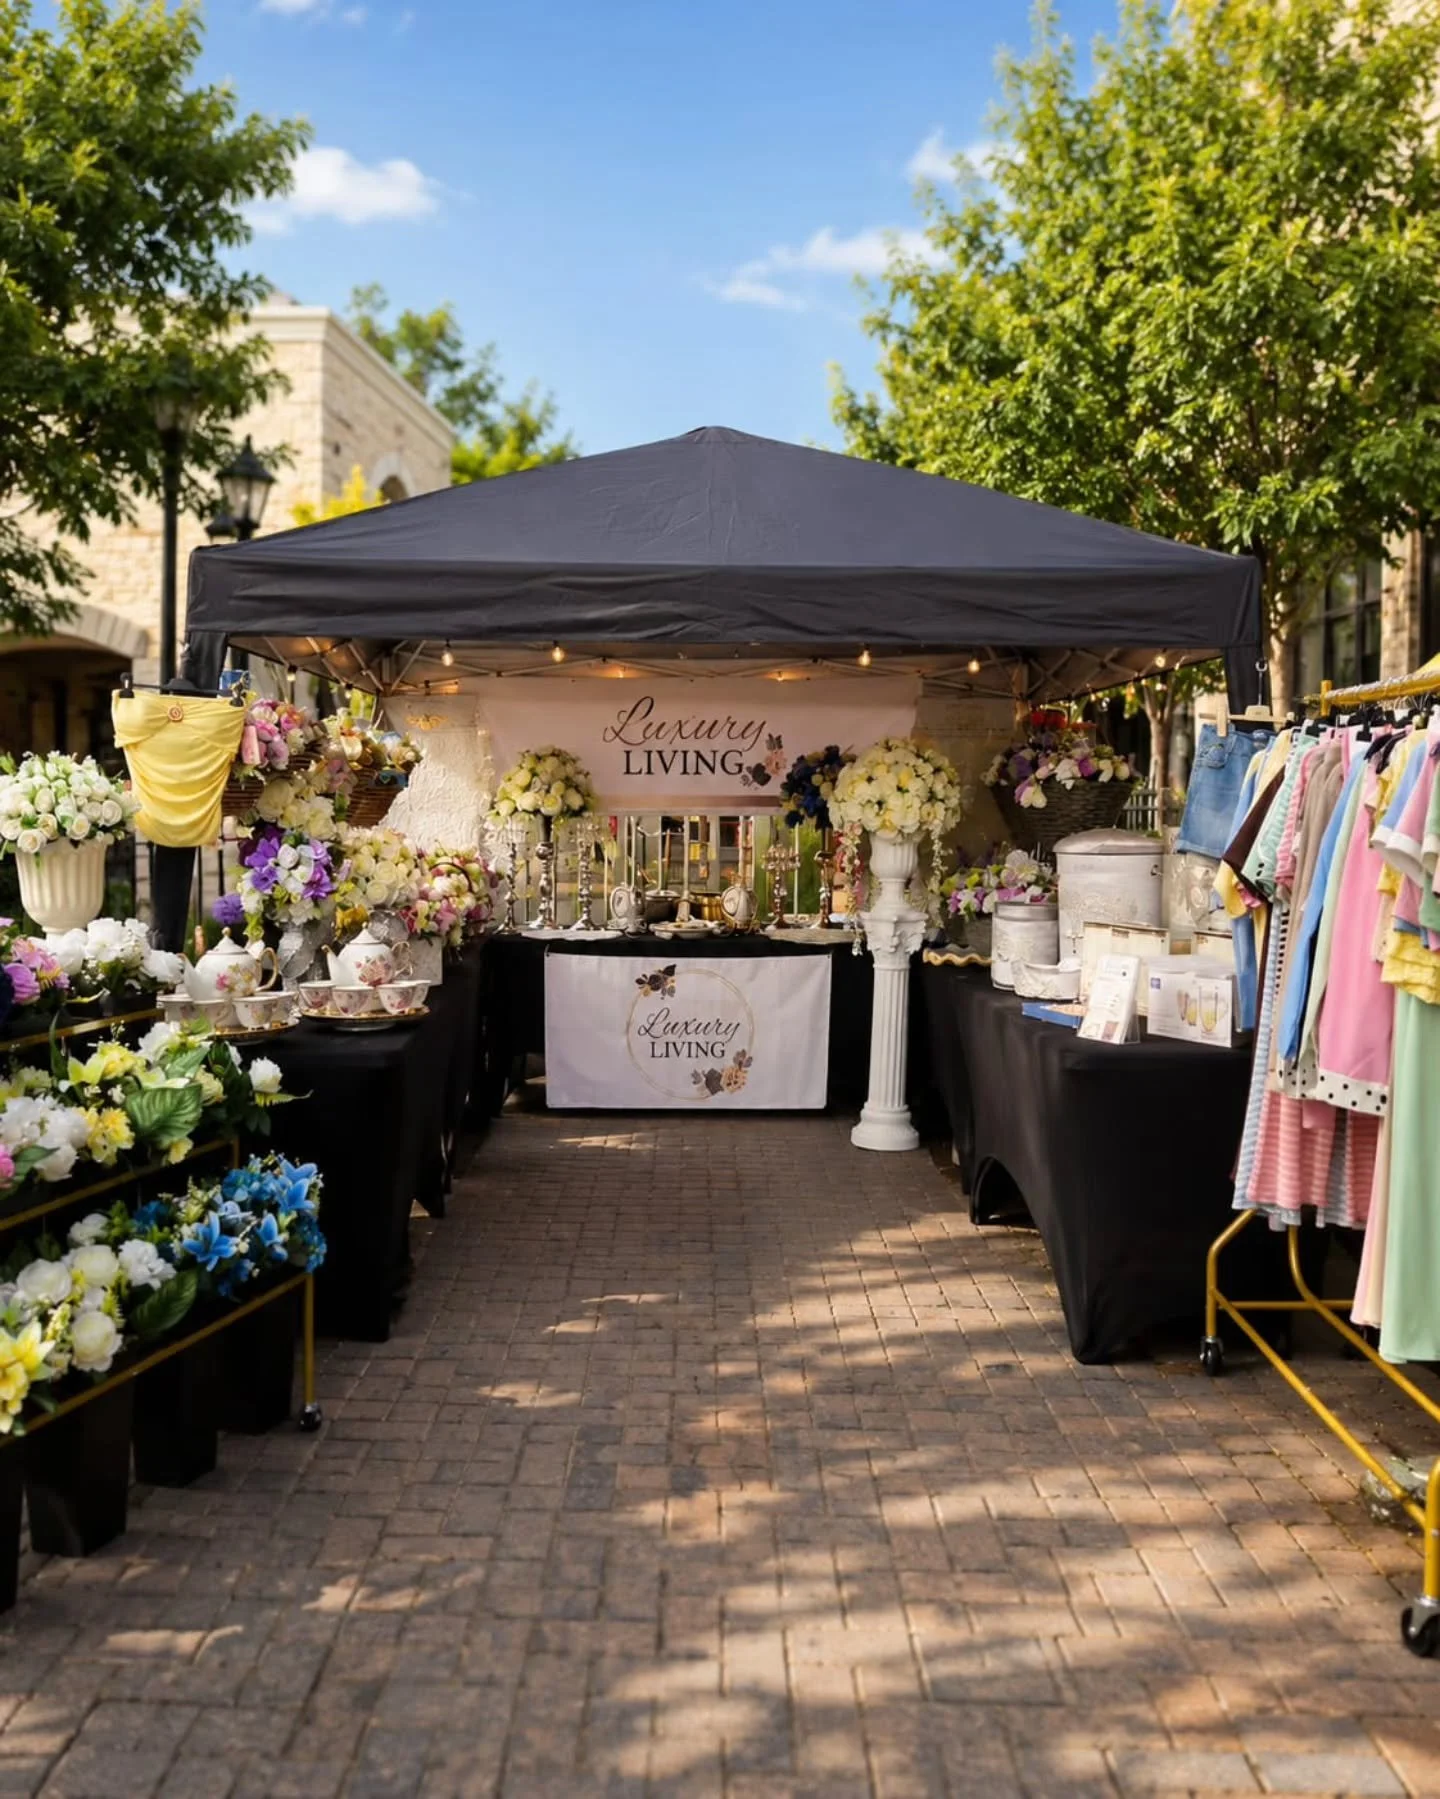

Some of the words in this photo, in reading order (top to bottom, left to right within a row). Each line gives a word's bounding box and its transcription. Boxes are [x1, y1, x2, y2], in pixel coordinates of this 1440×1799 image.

[602, 696, 767, 752] Luxury
[623, 749, 744, 775] LIVING
[637, 1007, 741, 1042] Luxury
[650, 1041, 726, 1059] LIVING
